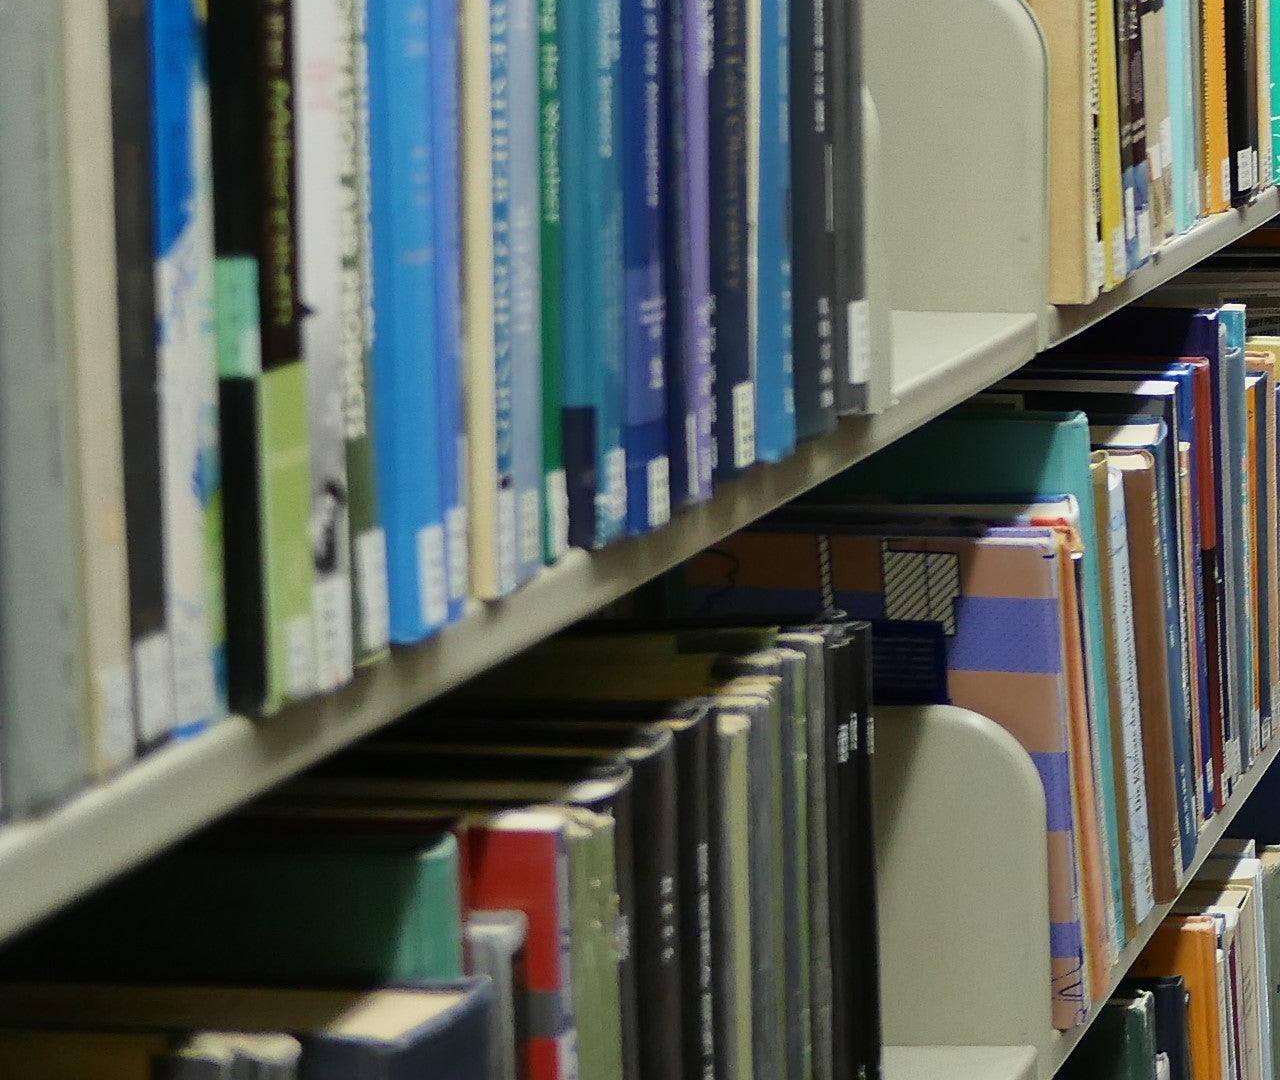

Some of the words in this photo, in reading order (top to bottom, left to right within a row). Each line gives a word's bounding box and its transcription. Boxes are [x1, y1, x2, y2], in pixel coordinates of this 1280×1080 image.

[1120, 565, 1132, 615] Vorzeit
[1123, 616, 1136, 704] geologischen
[1128, 707, 1137, 729] der
[1131, 732, 1141, 785] Klimate
